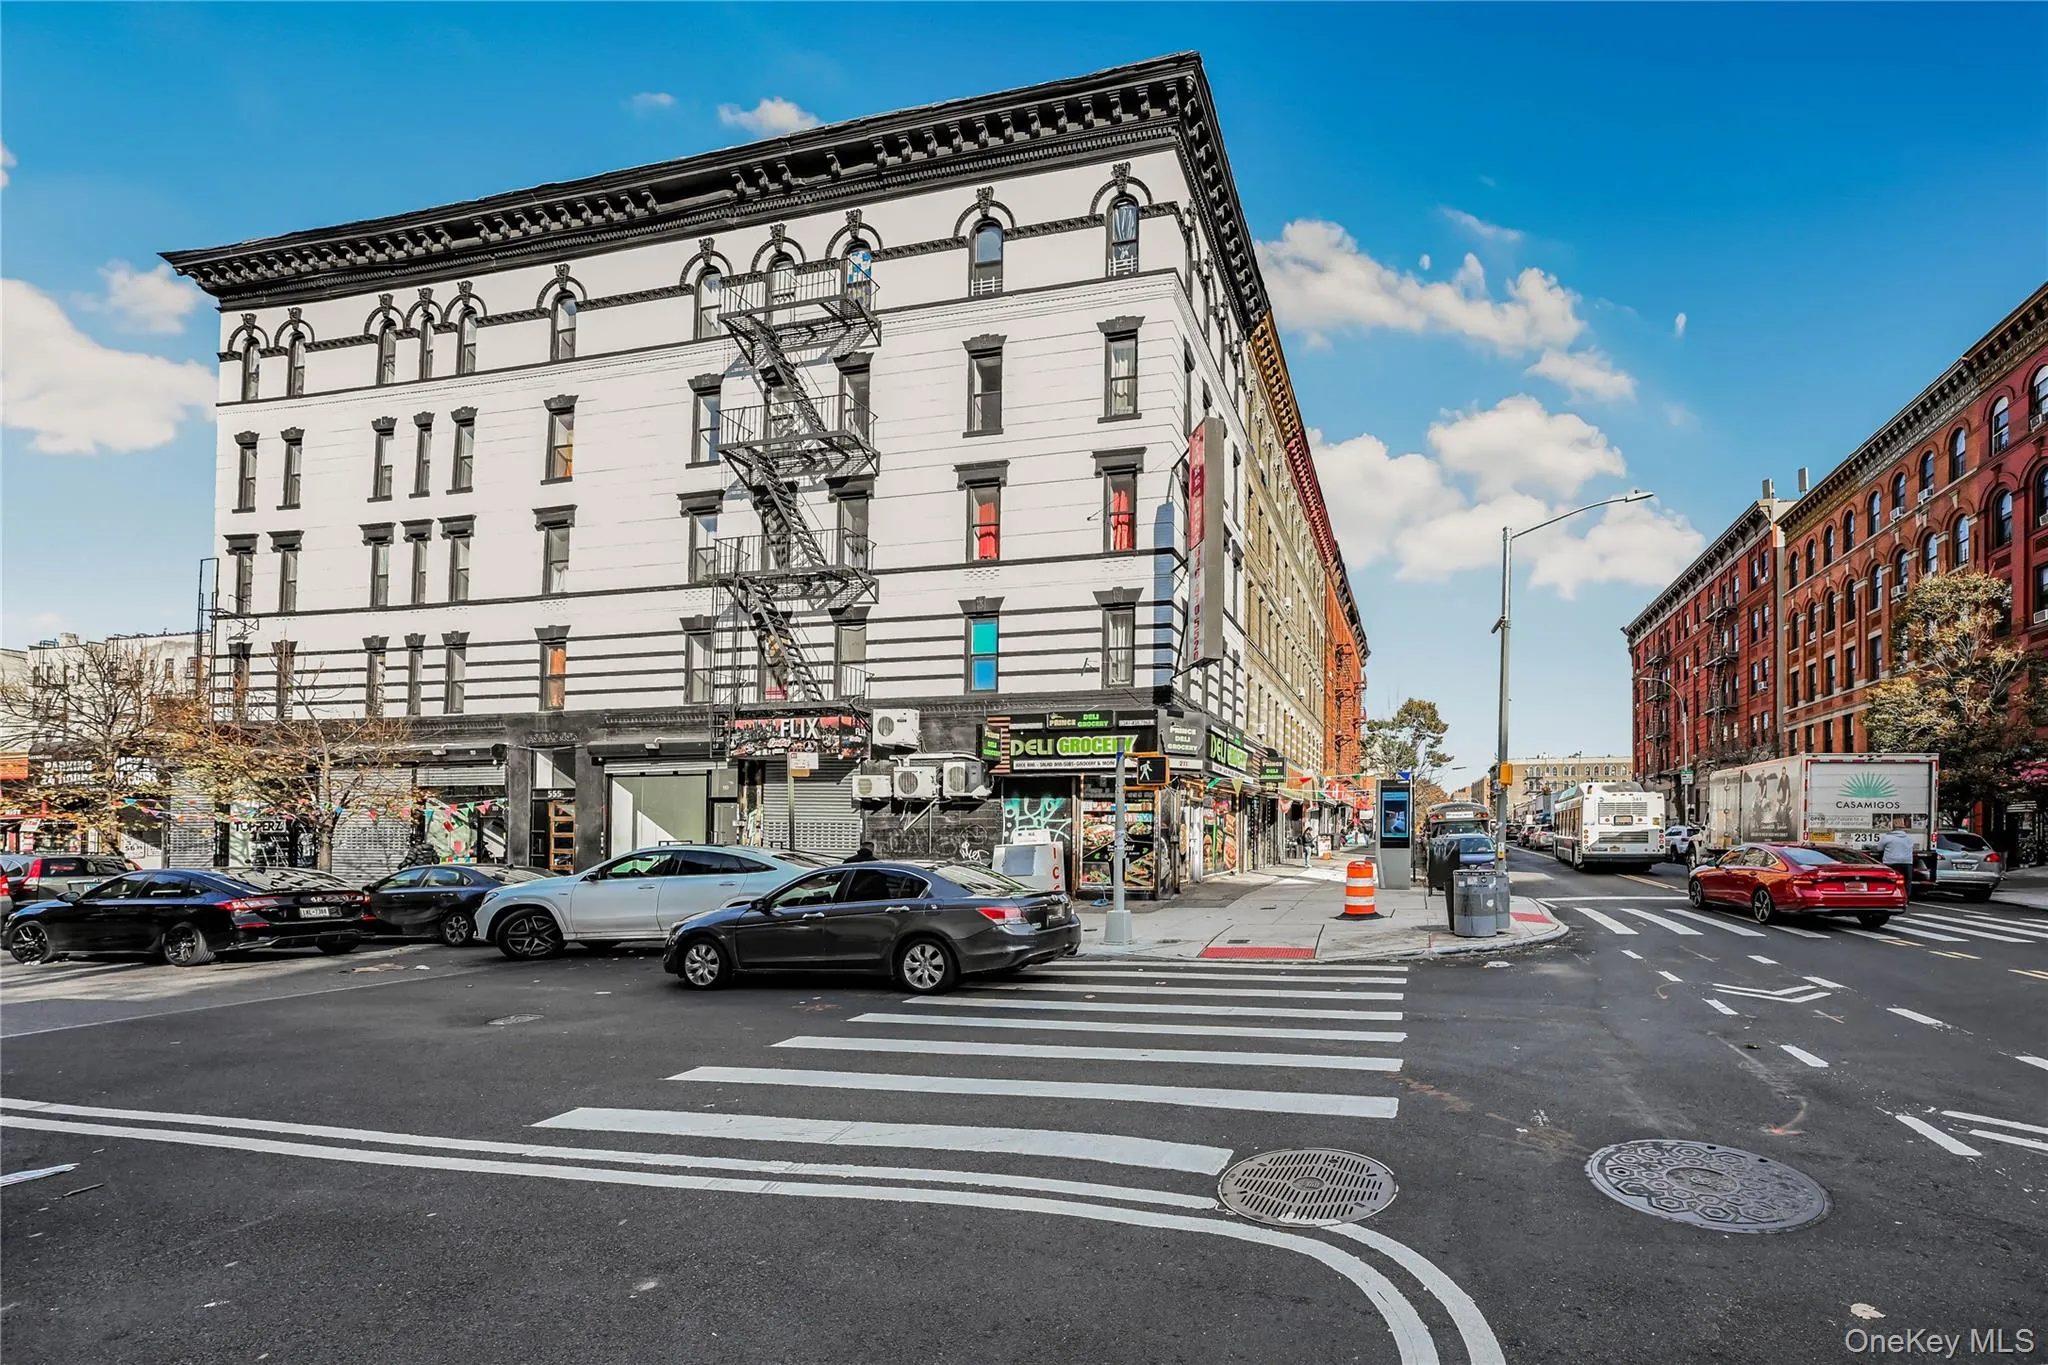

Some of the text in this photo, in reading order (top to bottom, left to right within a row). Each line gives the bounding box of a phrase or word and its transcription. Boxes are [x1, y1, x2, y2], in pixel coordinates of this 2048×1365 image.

[780, 719, 820, 739] FLIX
[1170, 726, 1196, 735] PRINCE
[1175, 735, 1191, 743] DELI
[1010, 738, 1054, 756] DELI
[1167, 743, 1198, 751] GROCERY
[1209, 734, 1227, 764] DELI
[1835, 800, 1900, 809] CASAMIGOS
[1854, 833, 1880, 842] 2315
